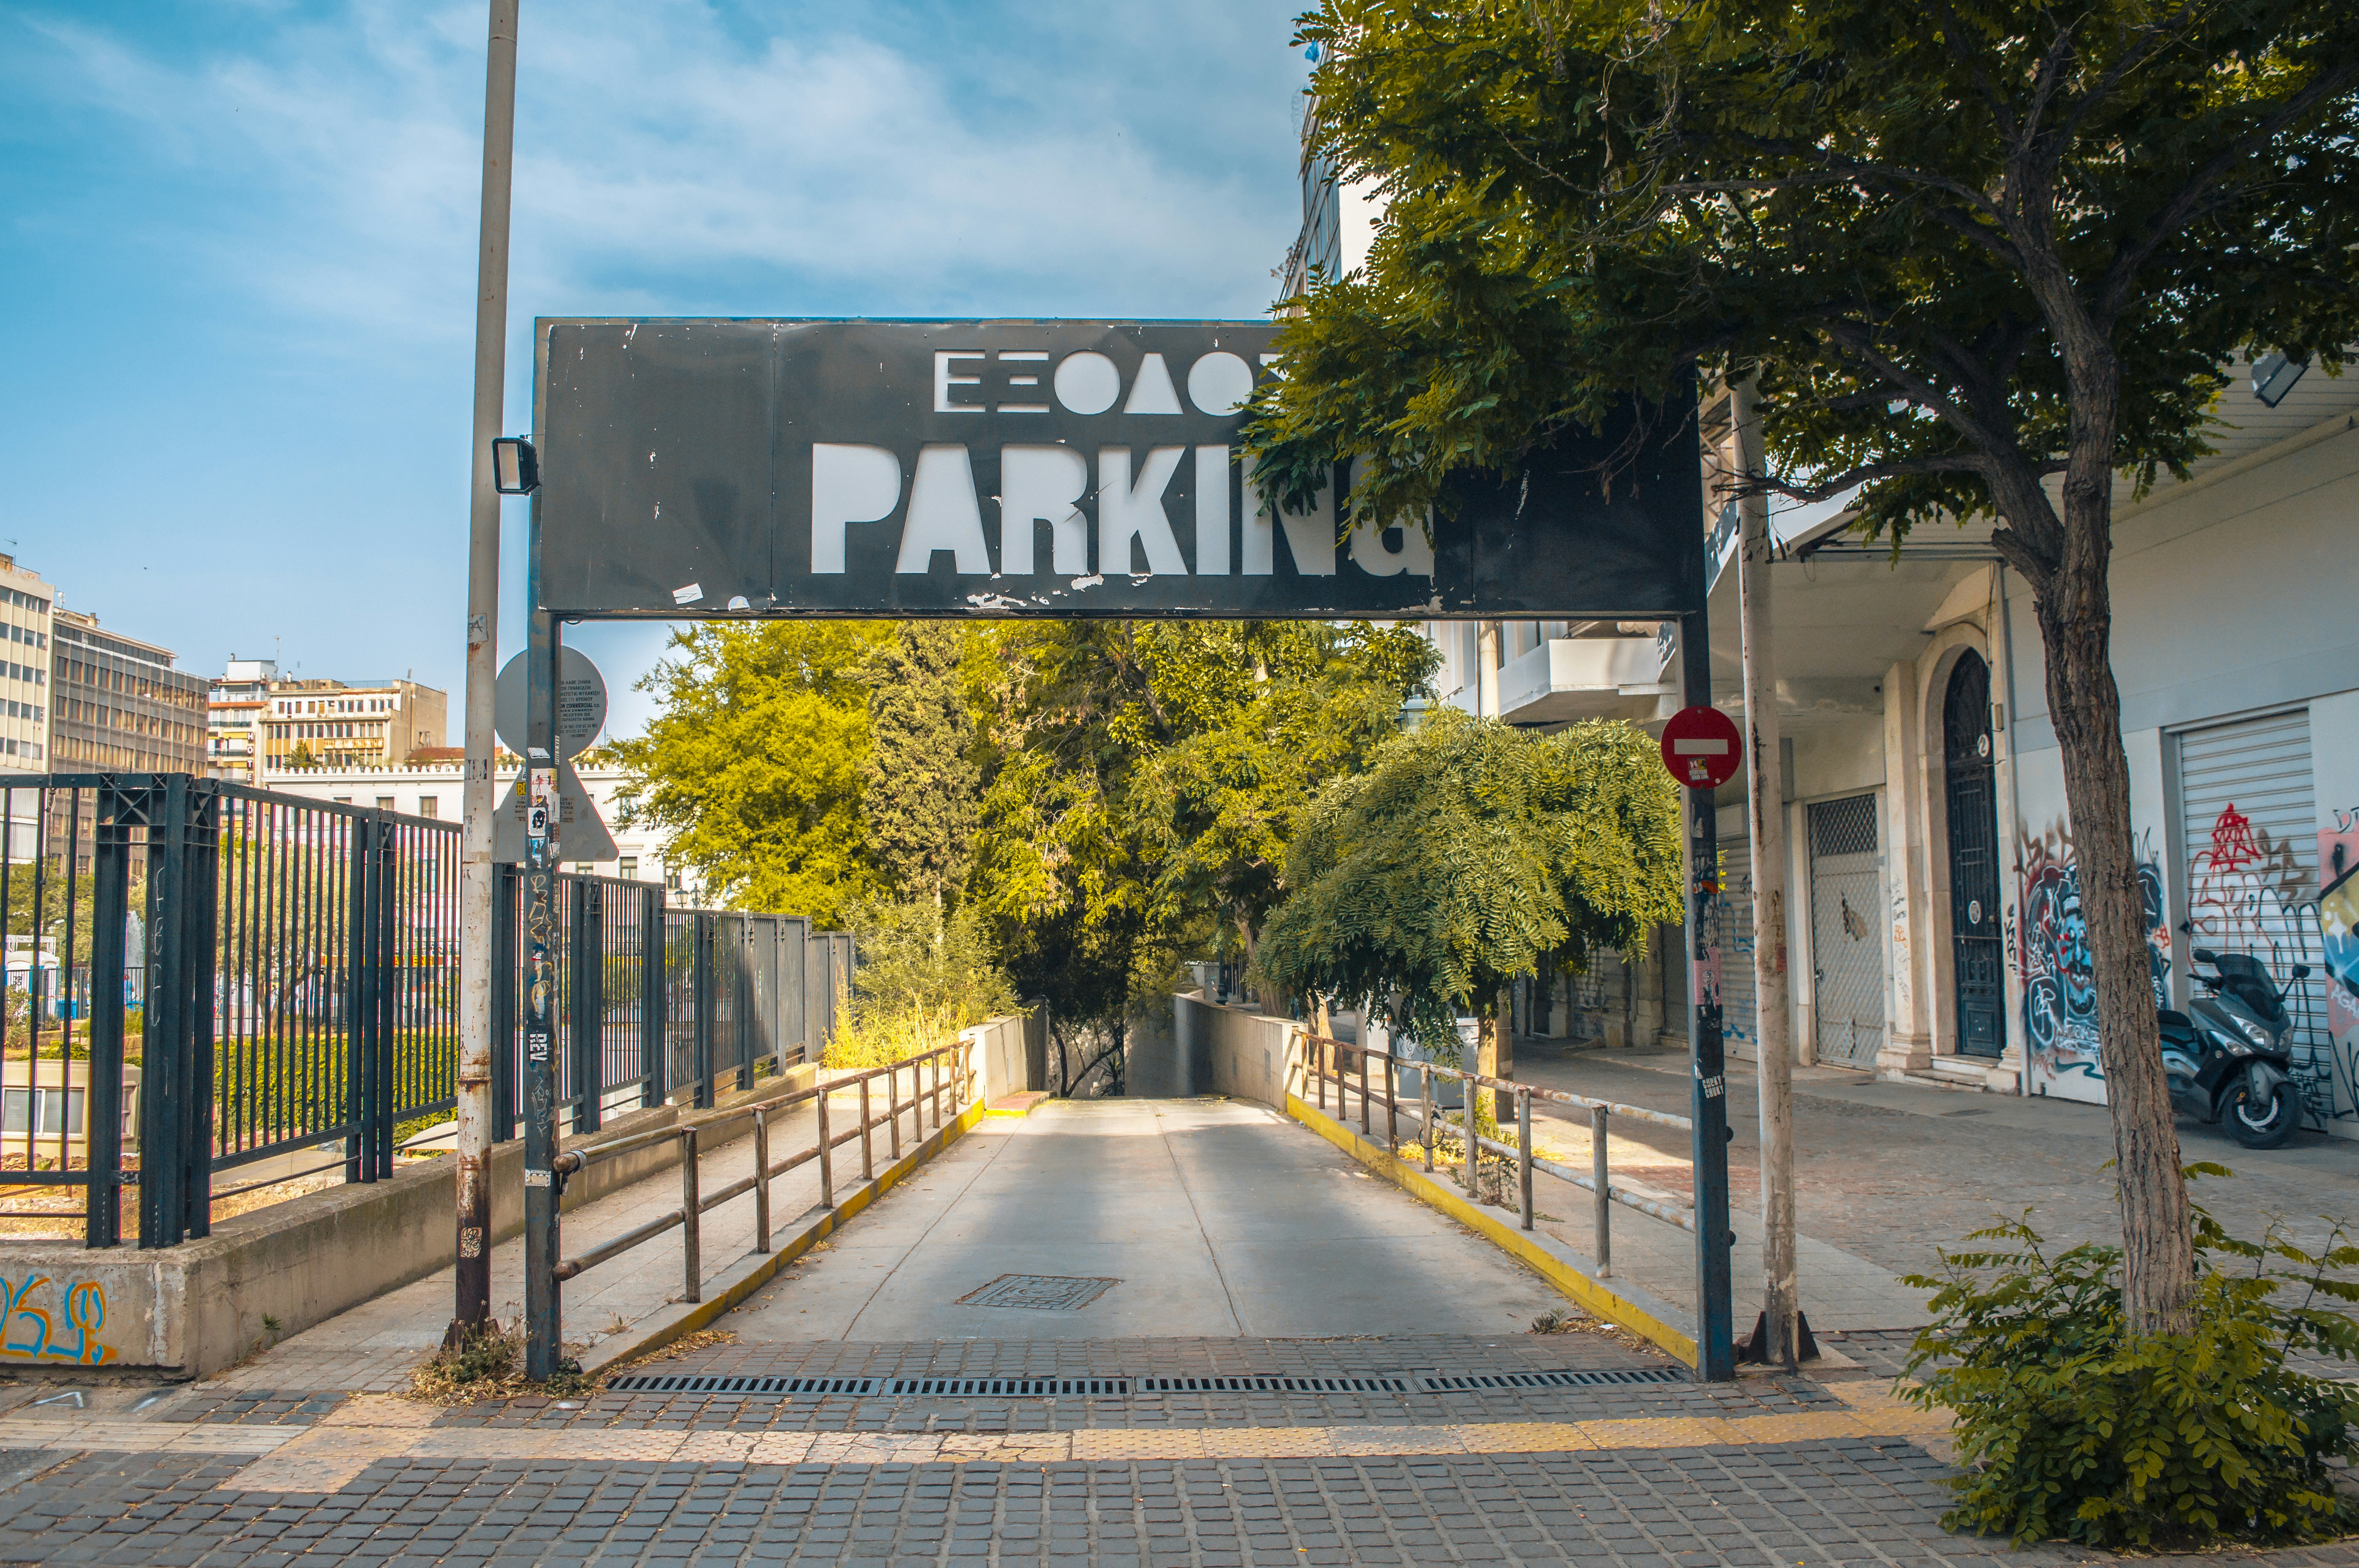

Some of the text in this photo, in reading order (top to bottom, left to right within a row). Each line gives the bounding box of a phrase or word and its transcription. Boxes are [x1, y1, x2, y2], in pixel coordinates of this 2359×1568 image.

[934, 348, 1293, 416] ΕΞΟΔΟ
[810, 442, 1434, 577] PARKING
[529, 1033, 548, 1061] REV
